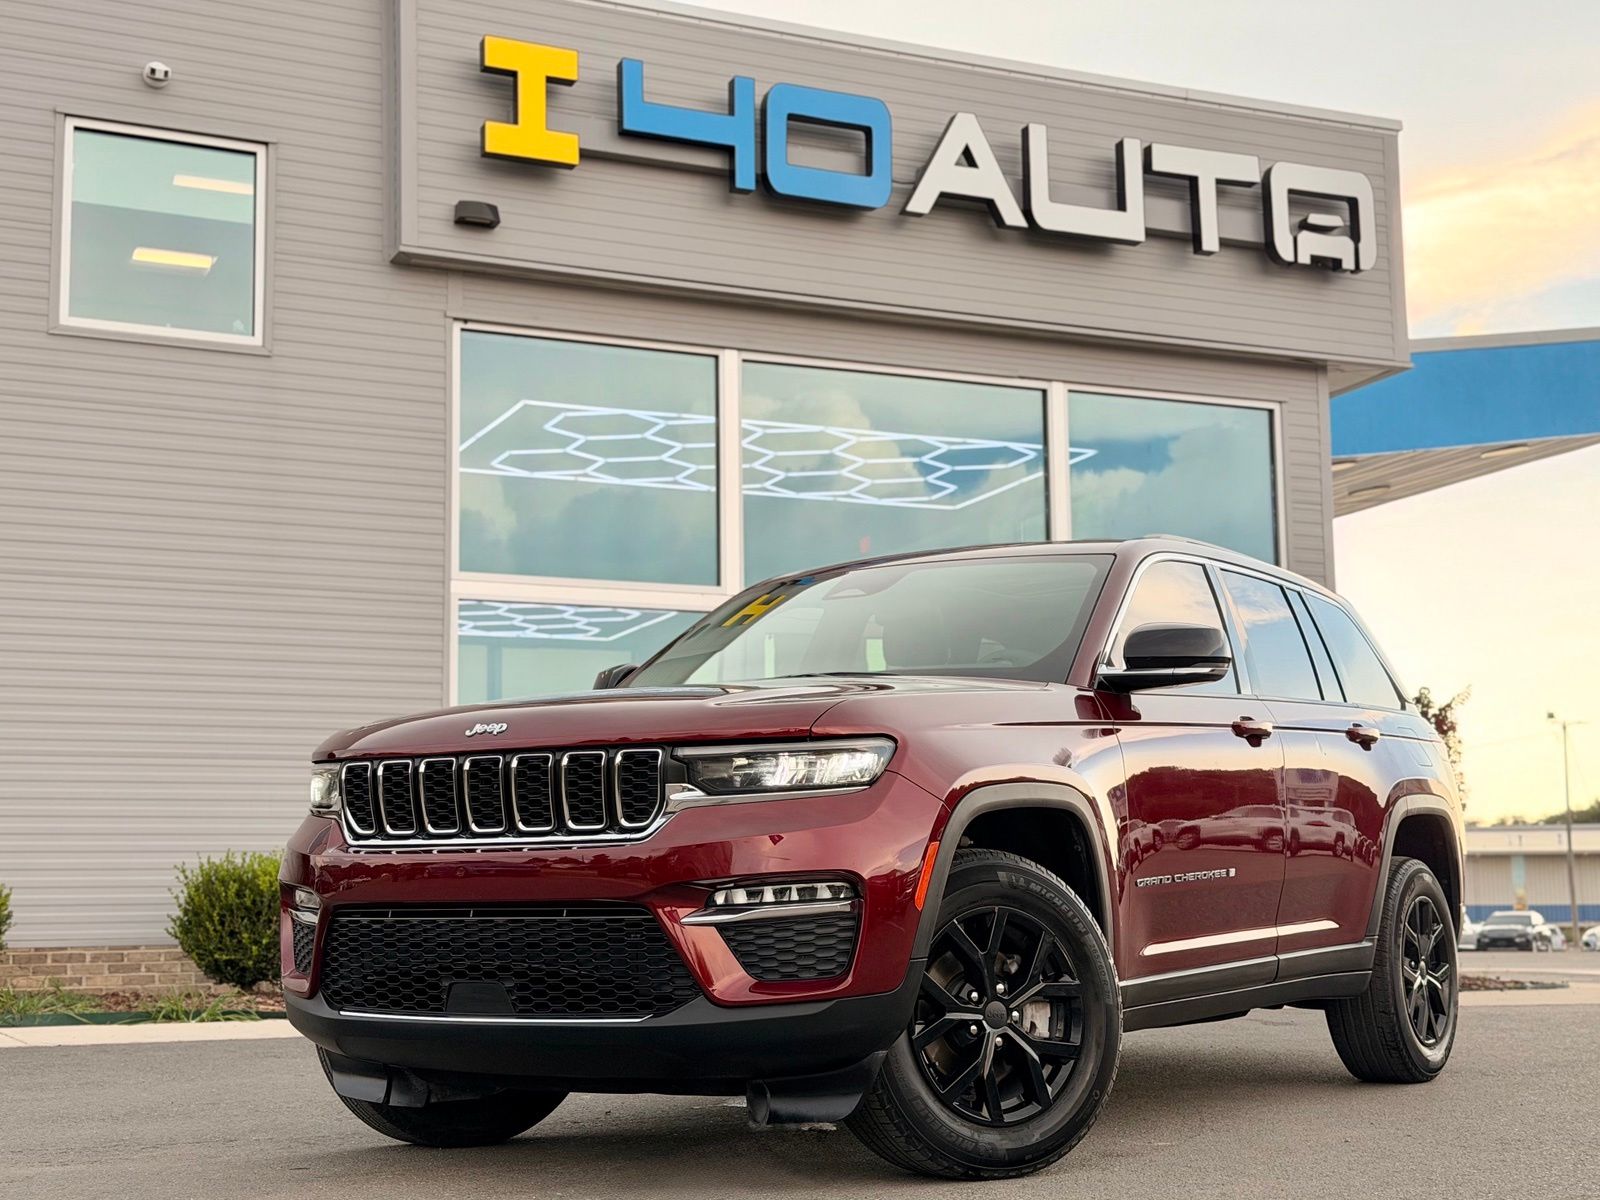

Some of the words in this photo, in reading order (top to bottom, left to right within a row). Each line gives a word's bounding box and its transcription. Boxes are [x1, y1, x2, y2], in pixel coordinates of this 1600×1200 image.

[465, 722, 508, 737] Jeep
[1136, 875, 1172, 888] GRAND
[1174, 869, 1227, 883] CHEROKEE
[1029, 882, 1087, 934] MICHELIN
